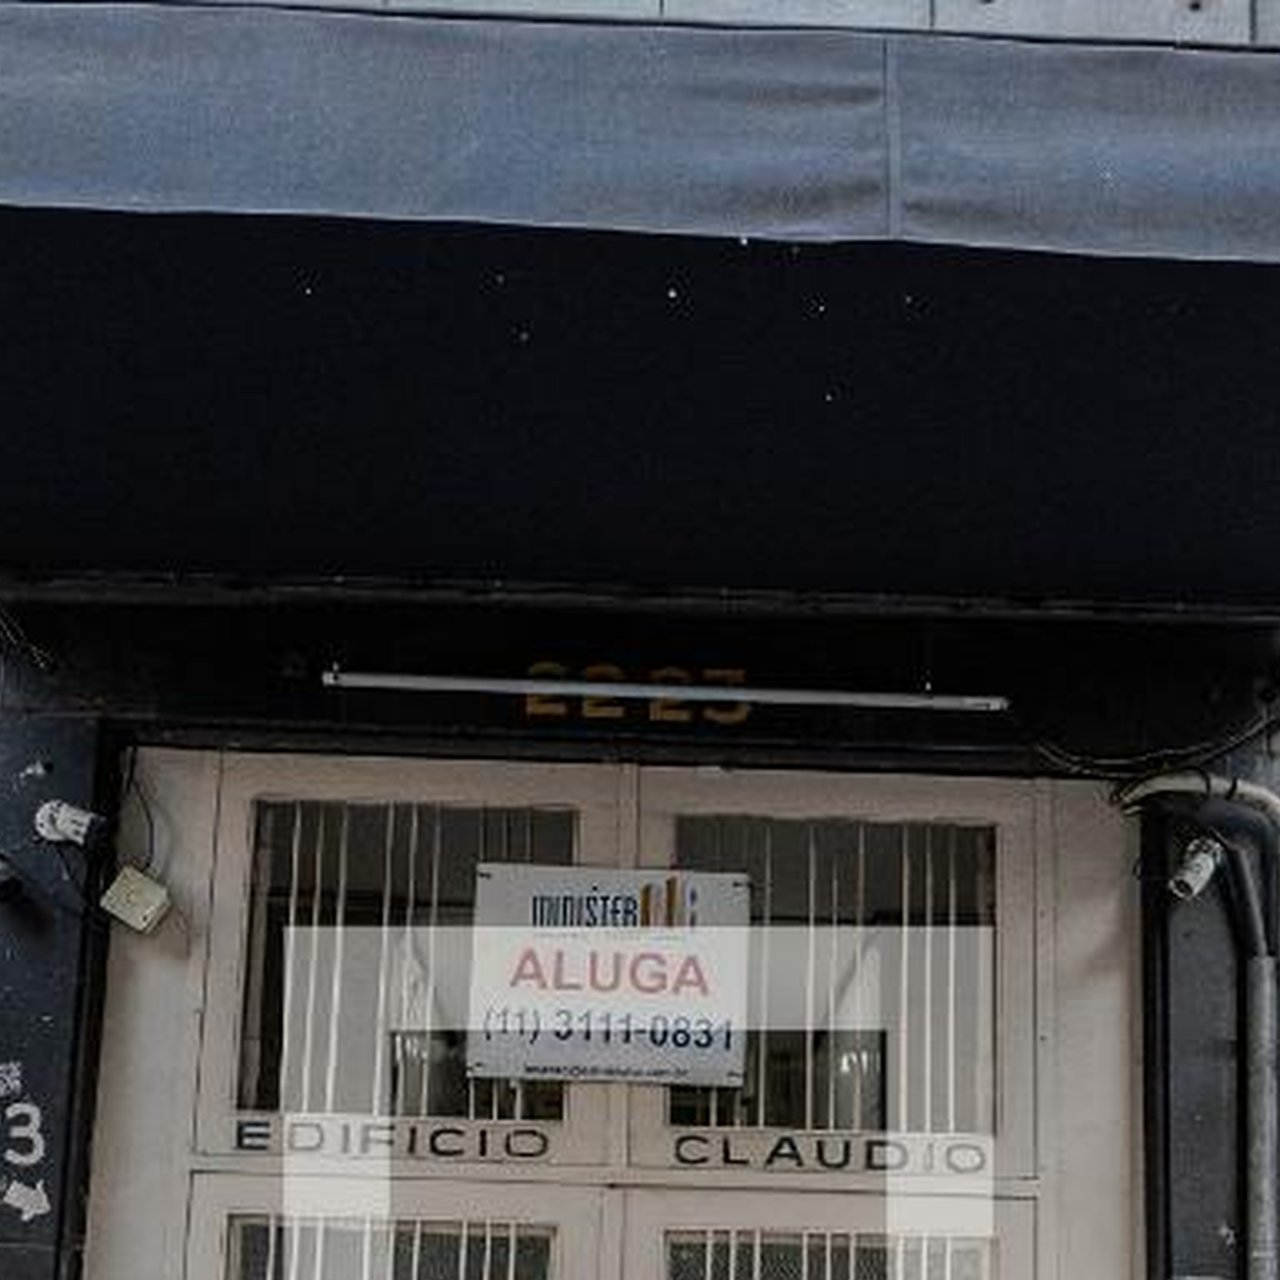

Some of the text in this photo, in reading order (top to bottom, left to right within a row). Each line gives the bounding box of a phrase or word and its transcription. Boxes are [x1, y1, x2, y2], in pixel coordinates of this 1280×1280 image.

[509, 949, 710, 996] ALUGA
[484, 1007, 732, 1051] (11) 3111-0831
[235, 1119, 986, 1173] EDIFICIO CLAUDIO
